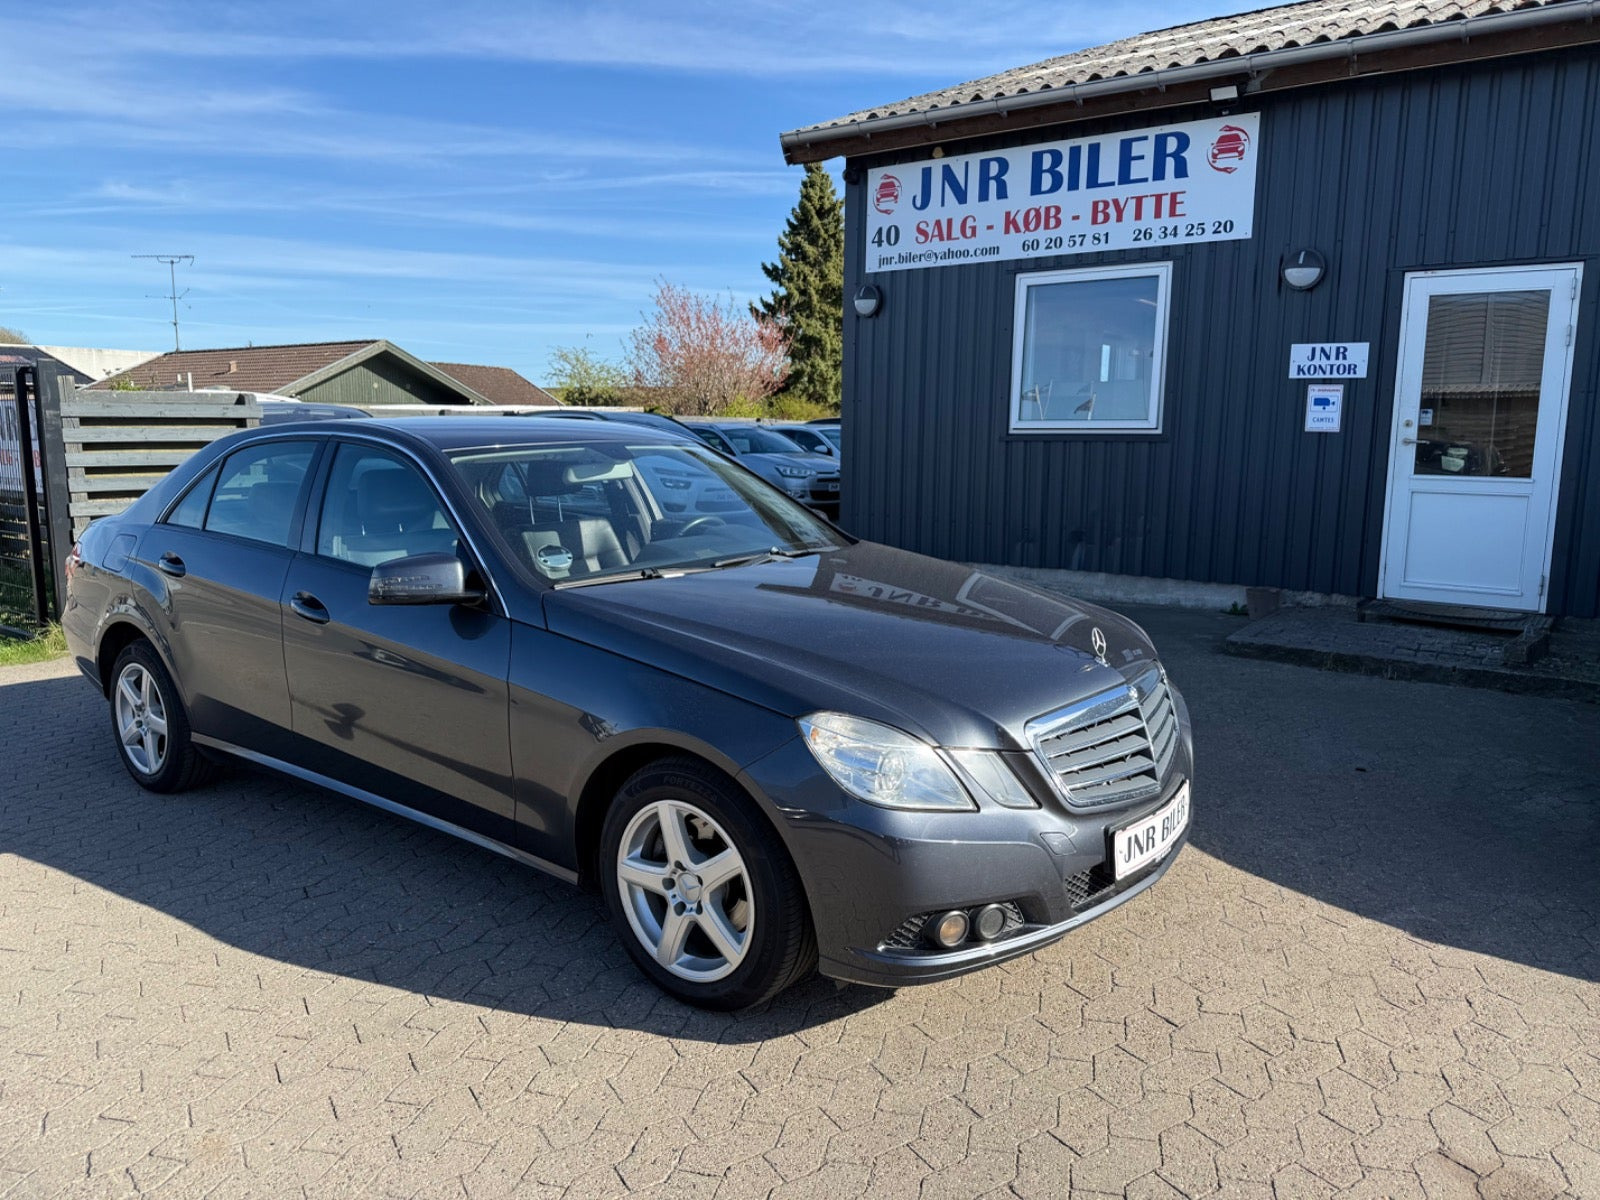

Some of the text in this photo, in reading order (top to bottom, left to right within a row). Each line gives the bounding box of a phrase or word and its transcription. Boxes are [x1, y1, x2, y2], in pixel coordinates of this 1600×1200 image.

[912, 131, 1191, 211] JNR BILER
[915, 214, 977, 244] SALG
[1003, 204, 1062, 235] KØB
[1090, 190, 1187, 226] BYTTE
[871, 224, 900, 248] 40
[1022, 231, 1110, 252] 60 20 57 81
[1132, 219, 1234, 242] 26 34 25 20
[878, 245, 1000, 269] jnr.biler@yahoo.com
[1307, 345, 1349, 362] JNR
[1296, 363, 1358, 376] KONTOR
[1124, 794, 1186, 864] JNR BILER
